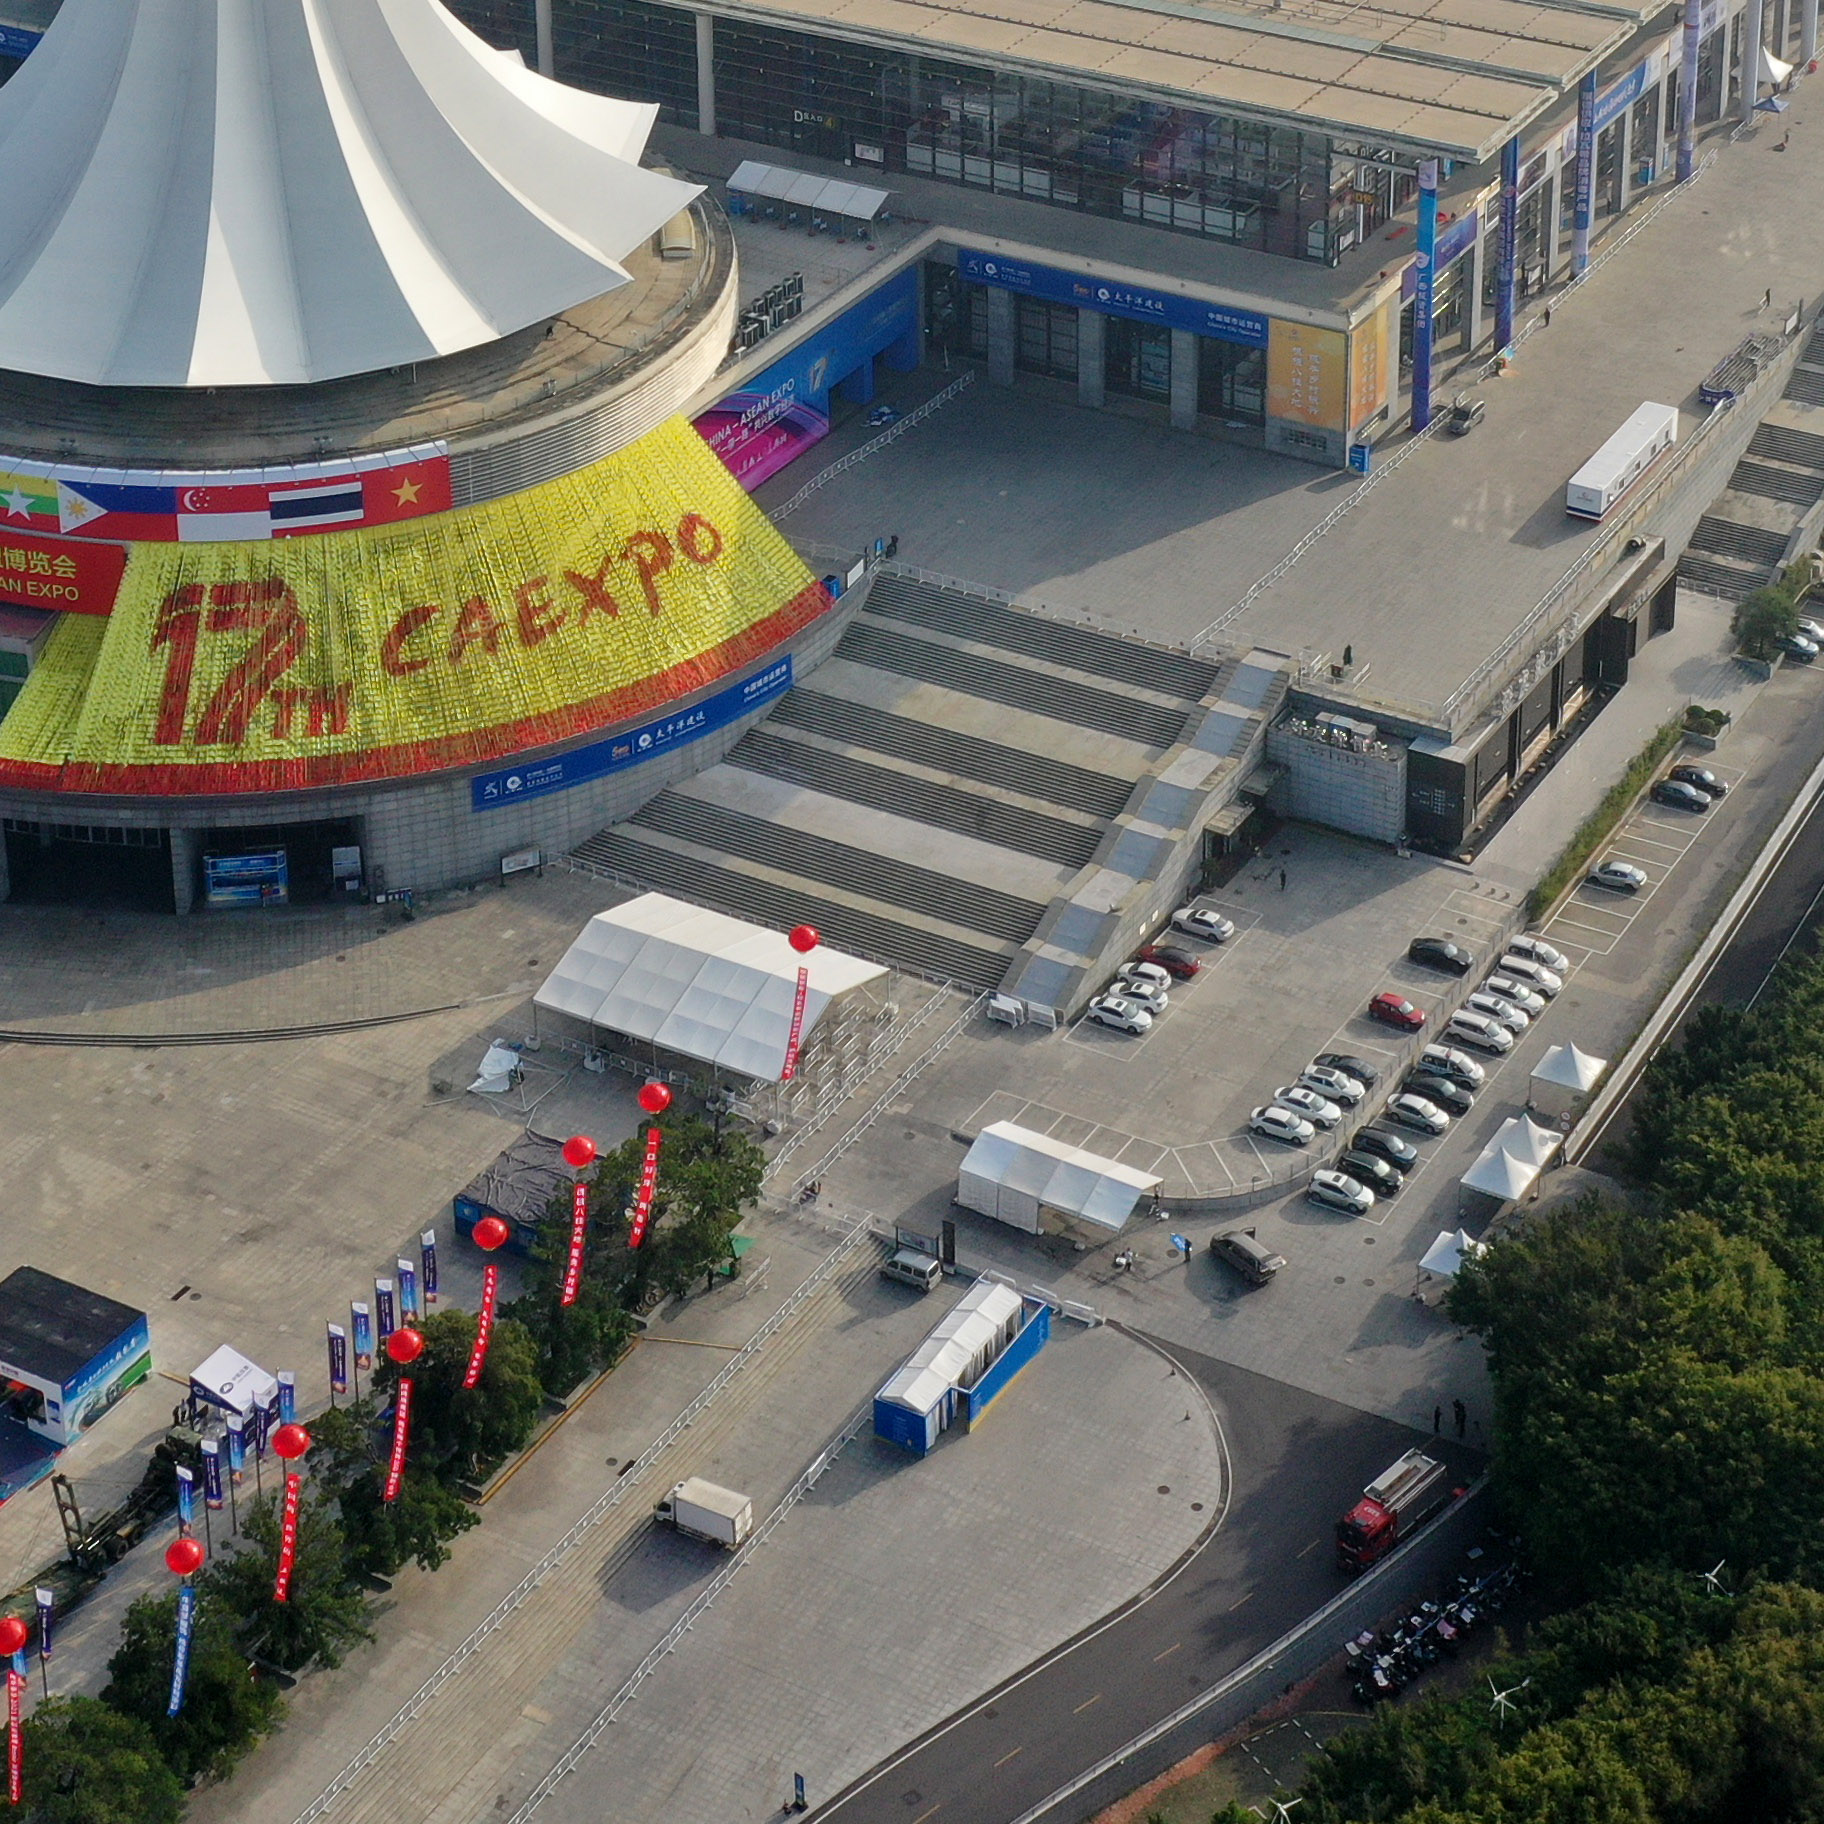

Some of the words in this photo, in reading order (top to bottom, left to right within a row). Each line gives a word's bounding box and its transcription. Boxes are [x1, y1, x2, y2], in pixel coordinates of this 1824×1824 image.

[740, 396, 770, 428] ASEAN
[771, 377, 796, 408] EXPO
[26, 580, 79, 601] EXPO
